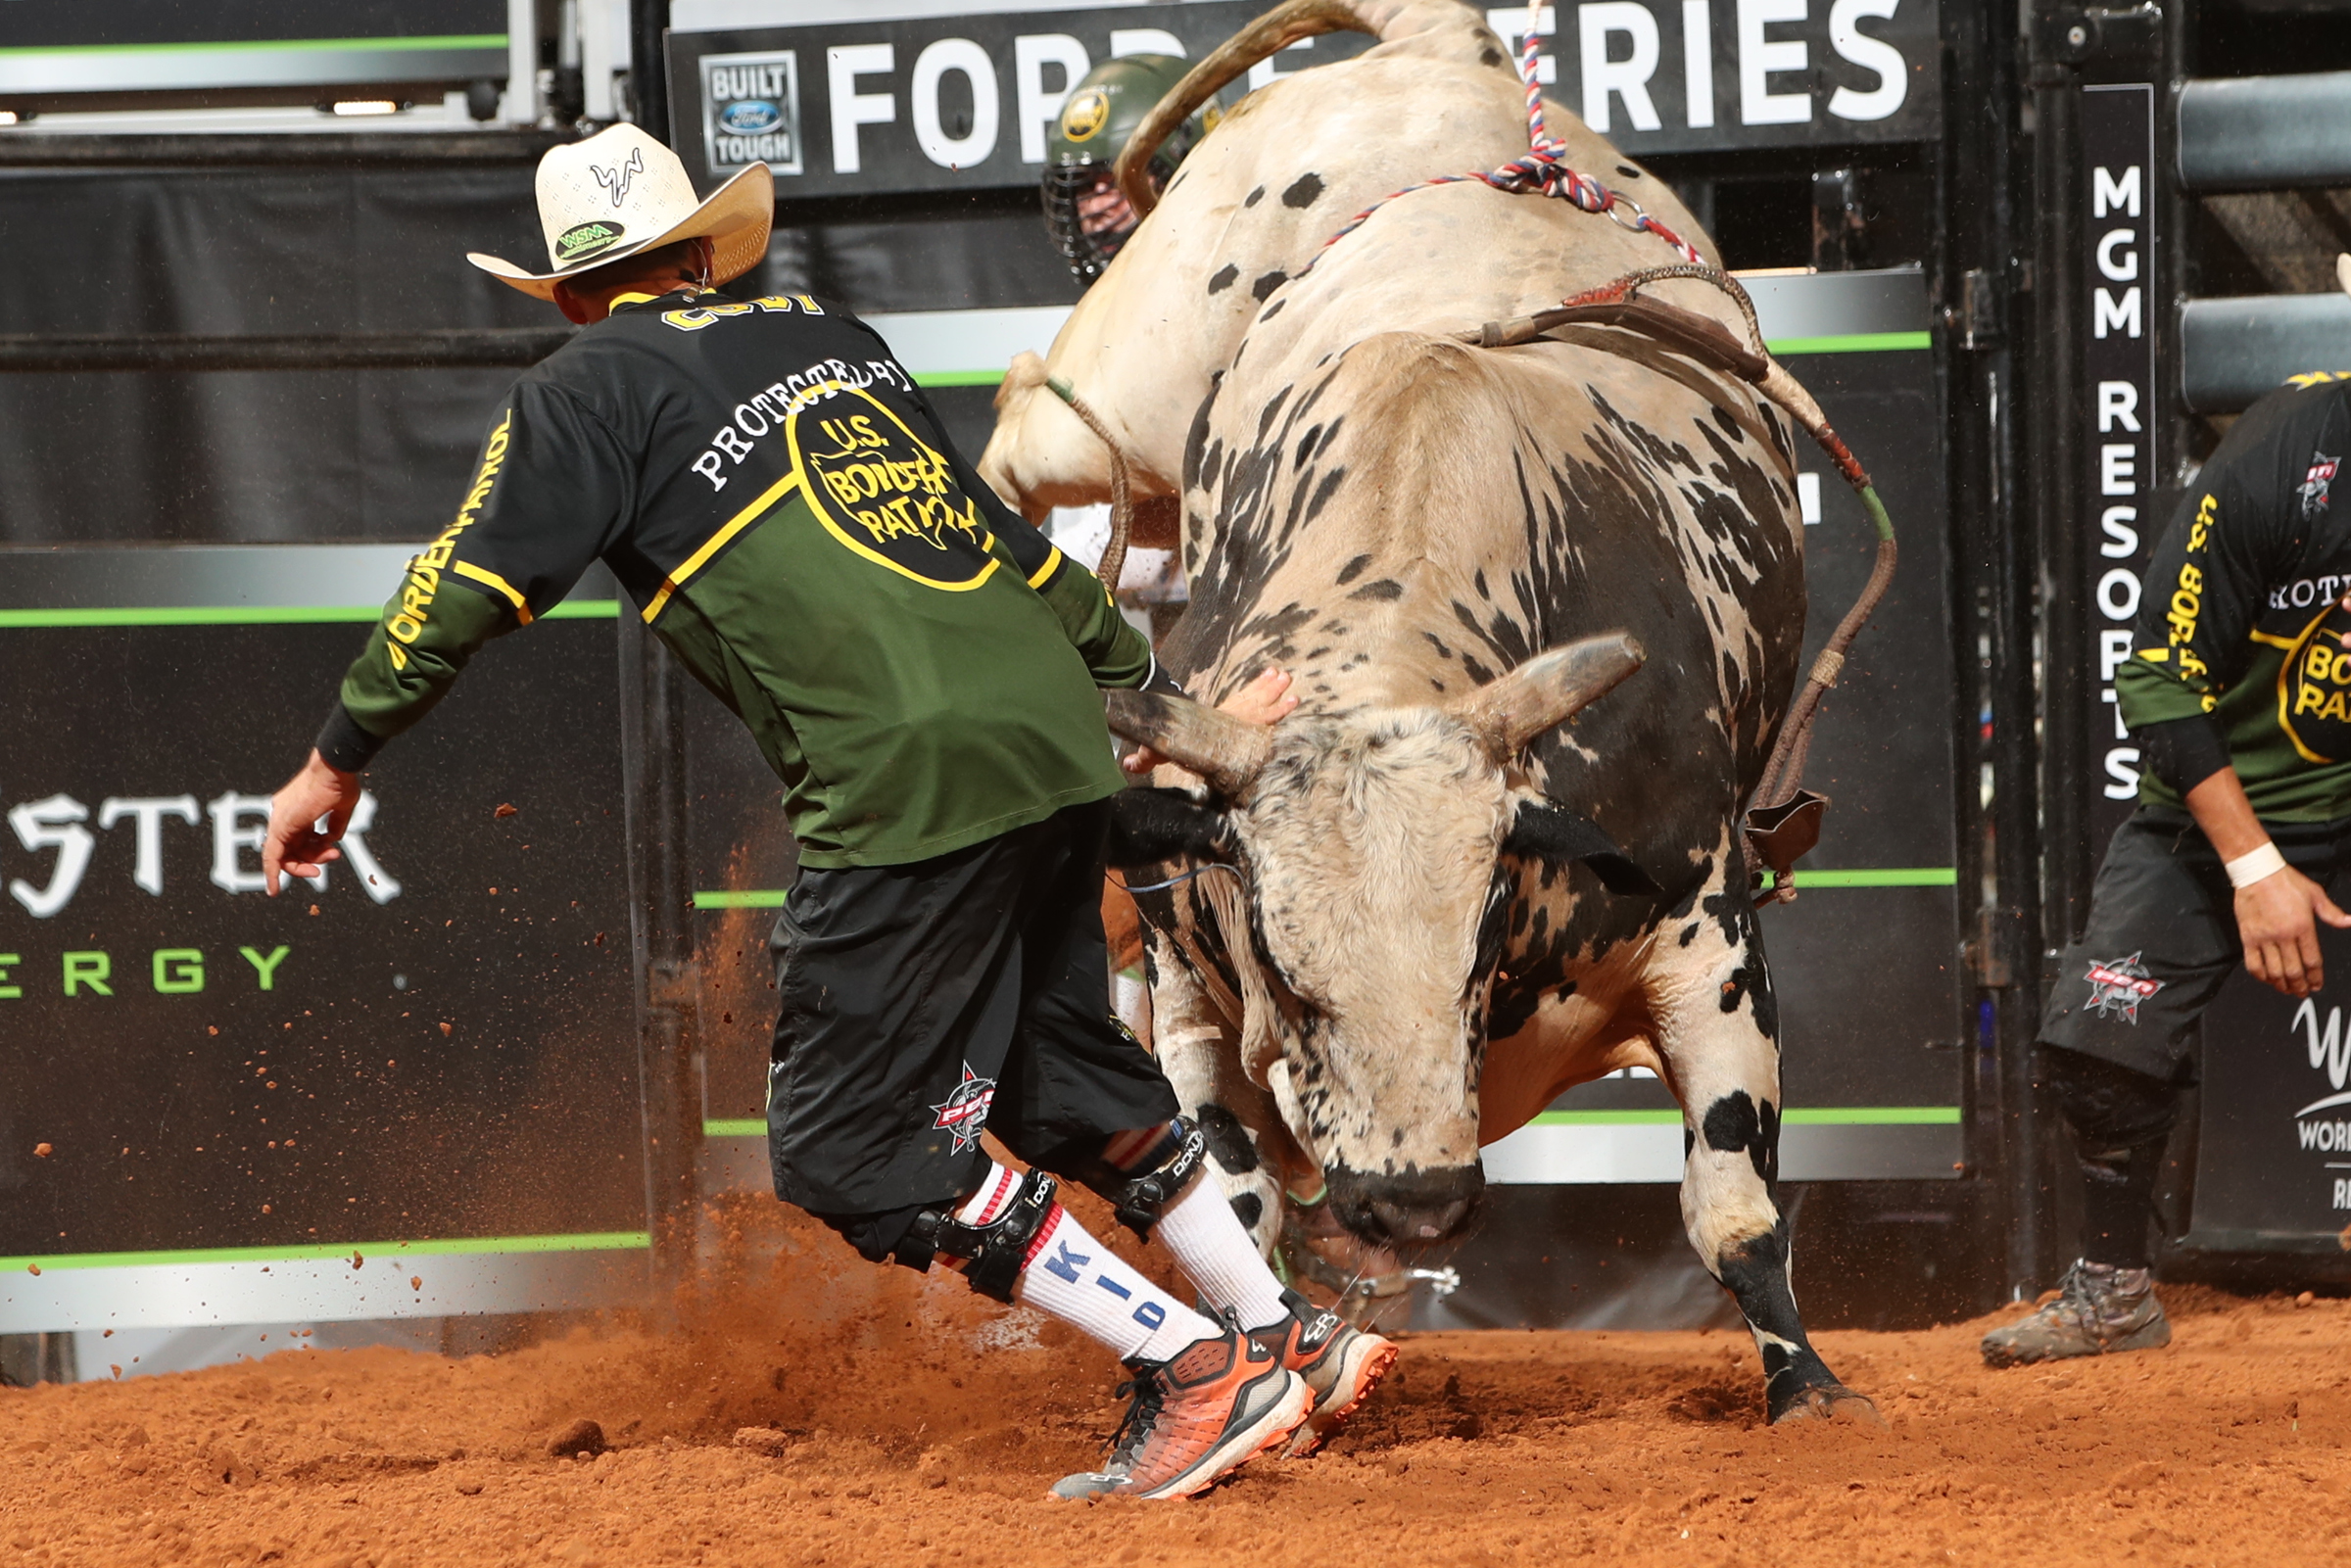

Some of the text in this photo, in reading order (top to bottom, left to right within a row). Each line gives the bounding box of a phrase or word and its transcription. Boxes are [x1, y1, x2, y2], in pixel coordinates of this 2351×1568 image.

[711, 65, 785, 100] BUILT
[827, 28, 1188, 173] FOR
[730, 105, 771, 127] Ford
[715, 133, 791, 164] TOUGH
[558, 223, 614, 249] WSM
[2092, 166, 2141, 340] MGM
[820, 414, 890, 451] U.S.
[1044, 1239, 1167, 1331] KID
